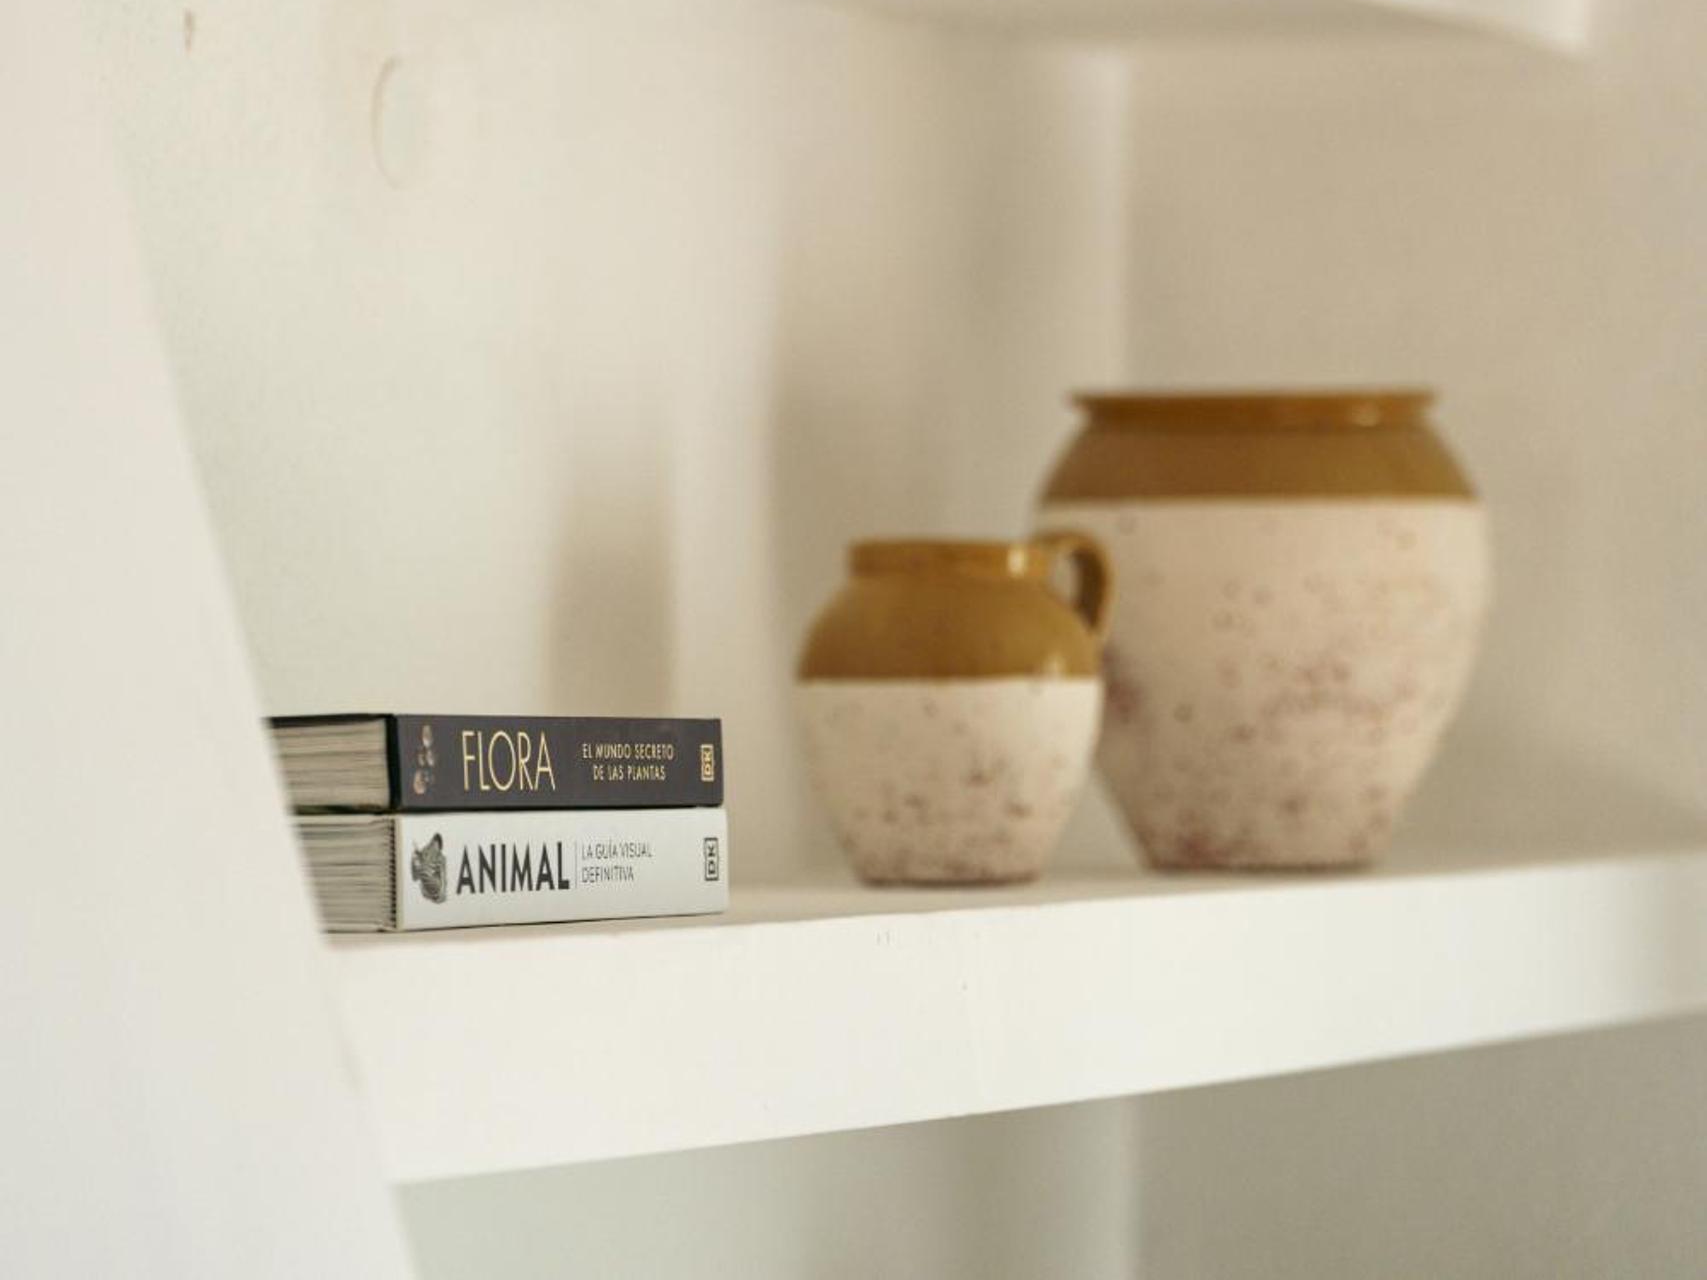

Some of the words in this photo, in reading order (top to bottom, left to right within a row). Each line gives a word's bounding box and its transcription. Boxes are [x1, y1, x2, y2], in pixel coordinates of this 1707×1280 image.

[462, 730, 556, 791] FLORA
[582, 743, 593, 759] EL
[595, 744, 631, 760] MUNDO
[634, 744, 674, 760] SECRETO
[702, 746, 713, 780] DK
[593, 765, 604, 781] DE
[608, 765, 624, 781] LAS
[627, 765, 666, 781] PLANTAS
[582, 843, 593, 860] LA
[620, 841, 653, 858] VISUAL
[706, 841, 718, 878] DK
[456, 841, 570, 894] ANIMAL
[582, 866, 634, 883] DEFINITIVA
